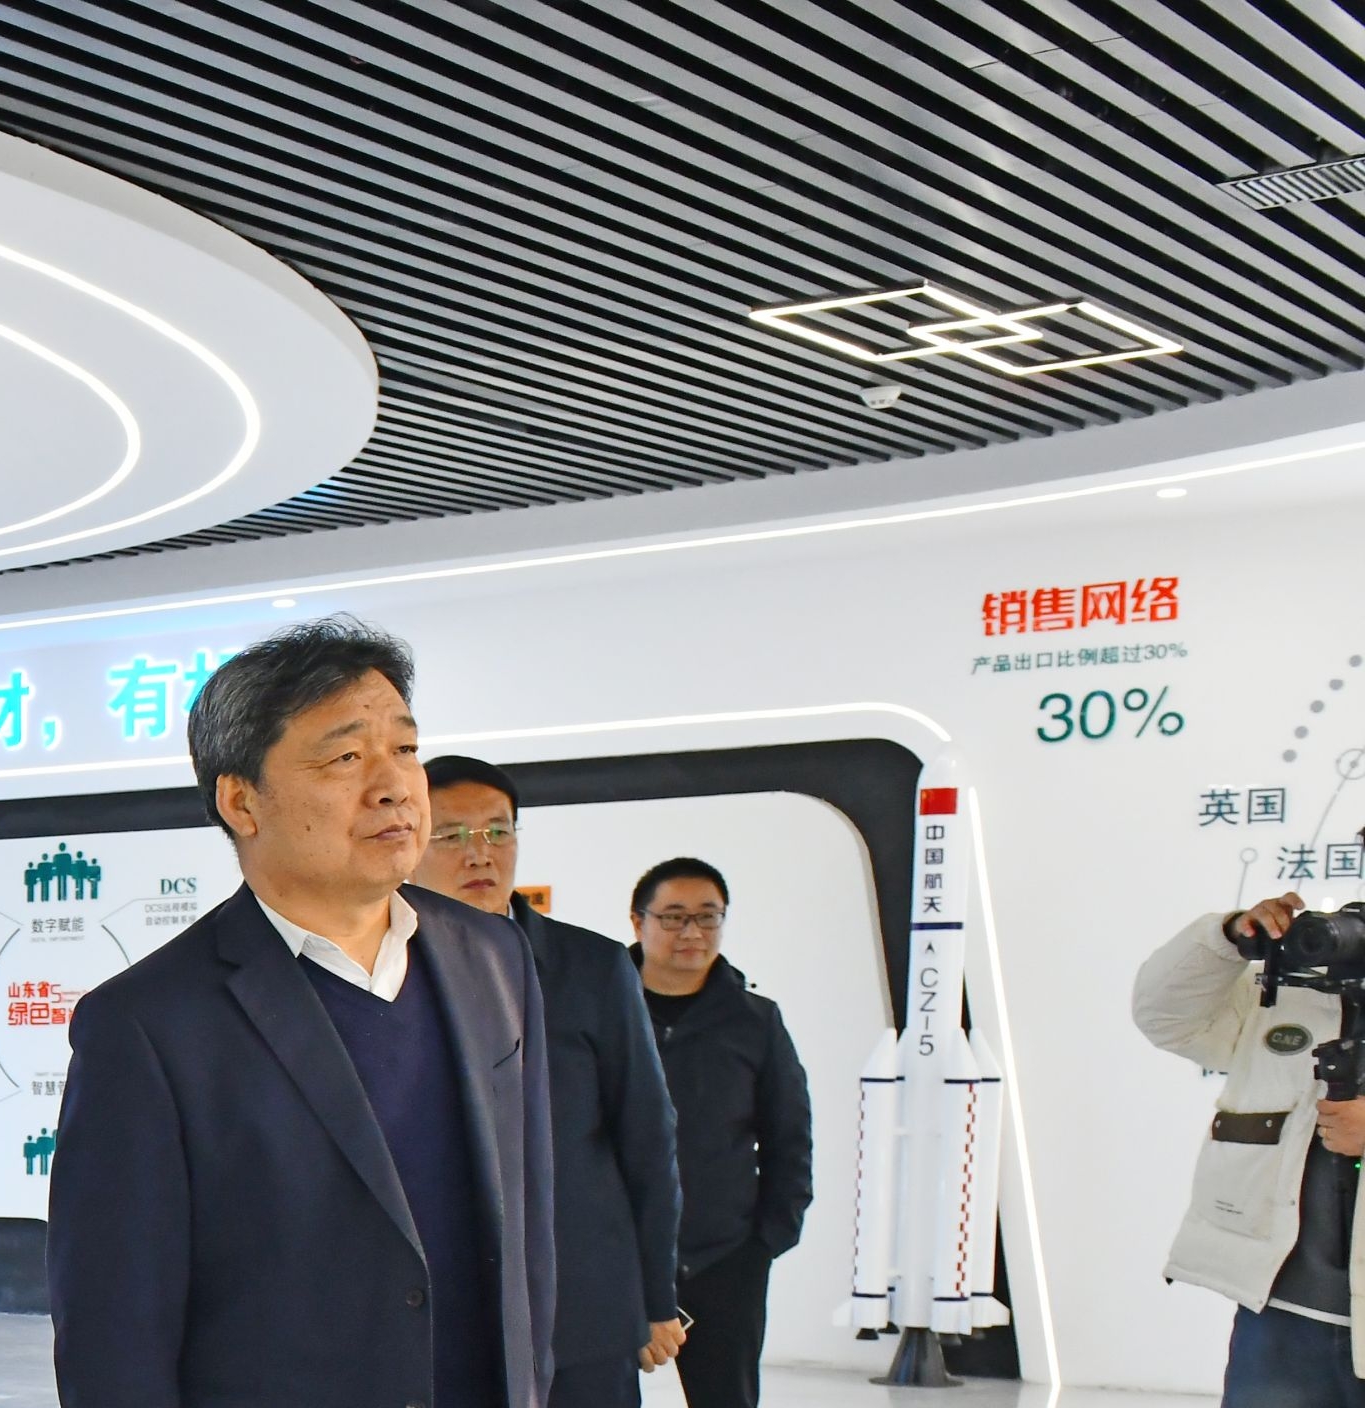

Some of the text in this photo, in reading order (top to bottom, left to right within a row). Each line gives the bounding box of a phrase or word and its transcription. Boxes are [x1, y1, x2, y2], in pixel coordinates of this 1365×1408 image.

[982, 577, 1178, 636] 销售网络
[971, 641, 1188, 675] 产品出口比例超过30%
[1037, 685, 1185, 742] 30%
[1199, 787, 1286, 826] 英国
[923, 824, 945, 913] 中国航天
[1277, 843, 1364, 880] 法国
[160, 877, 197, 895] DCS
[32, 917, 84, 934] 数字赋能
[8, 981, 49, 998] 山东省
[8, 1002, 74, 1025] 绿色智
